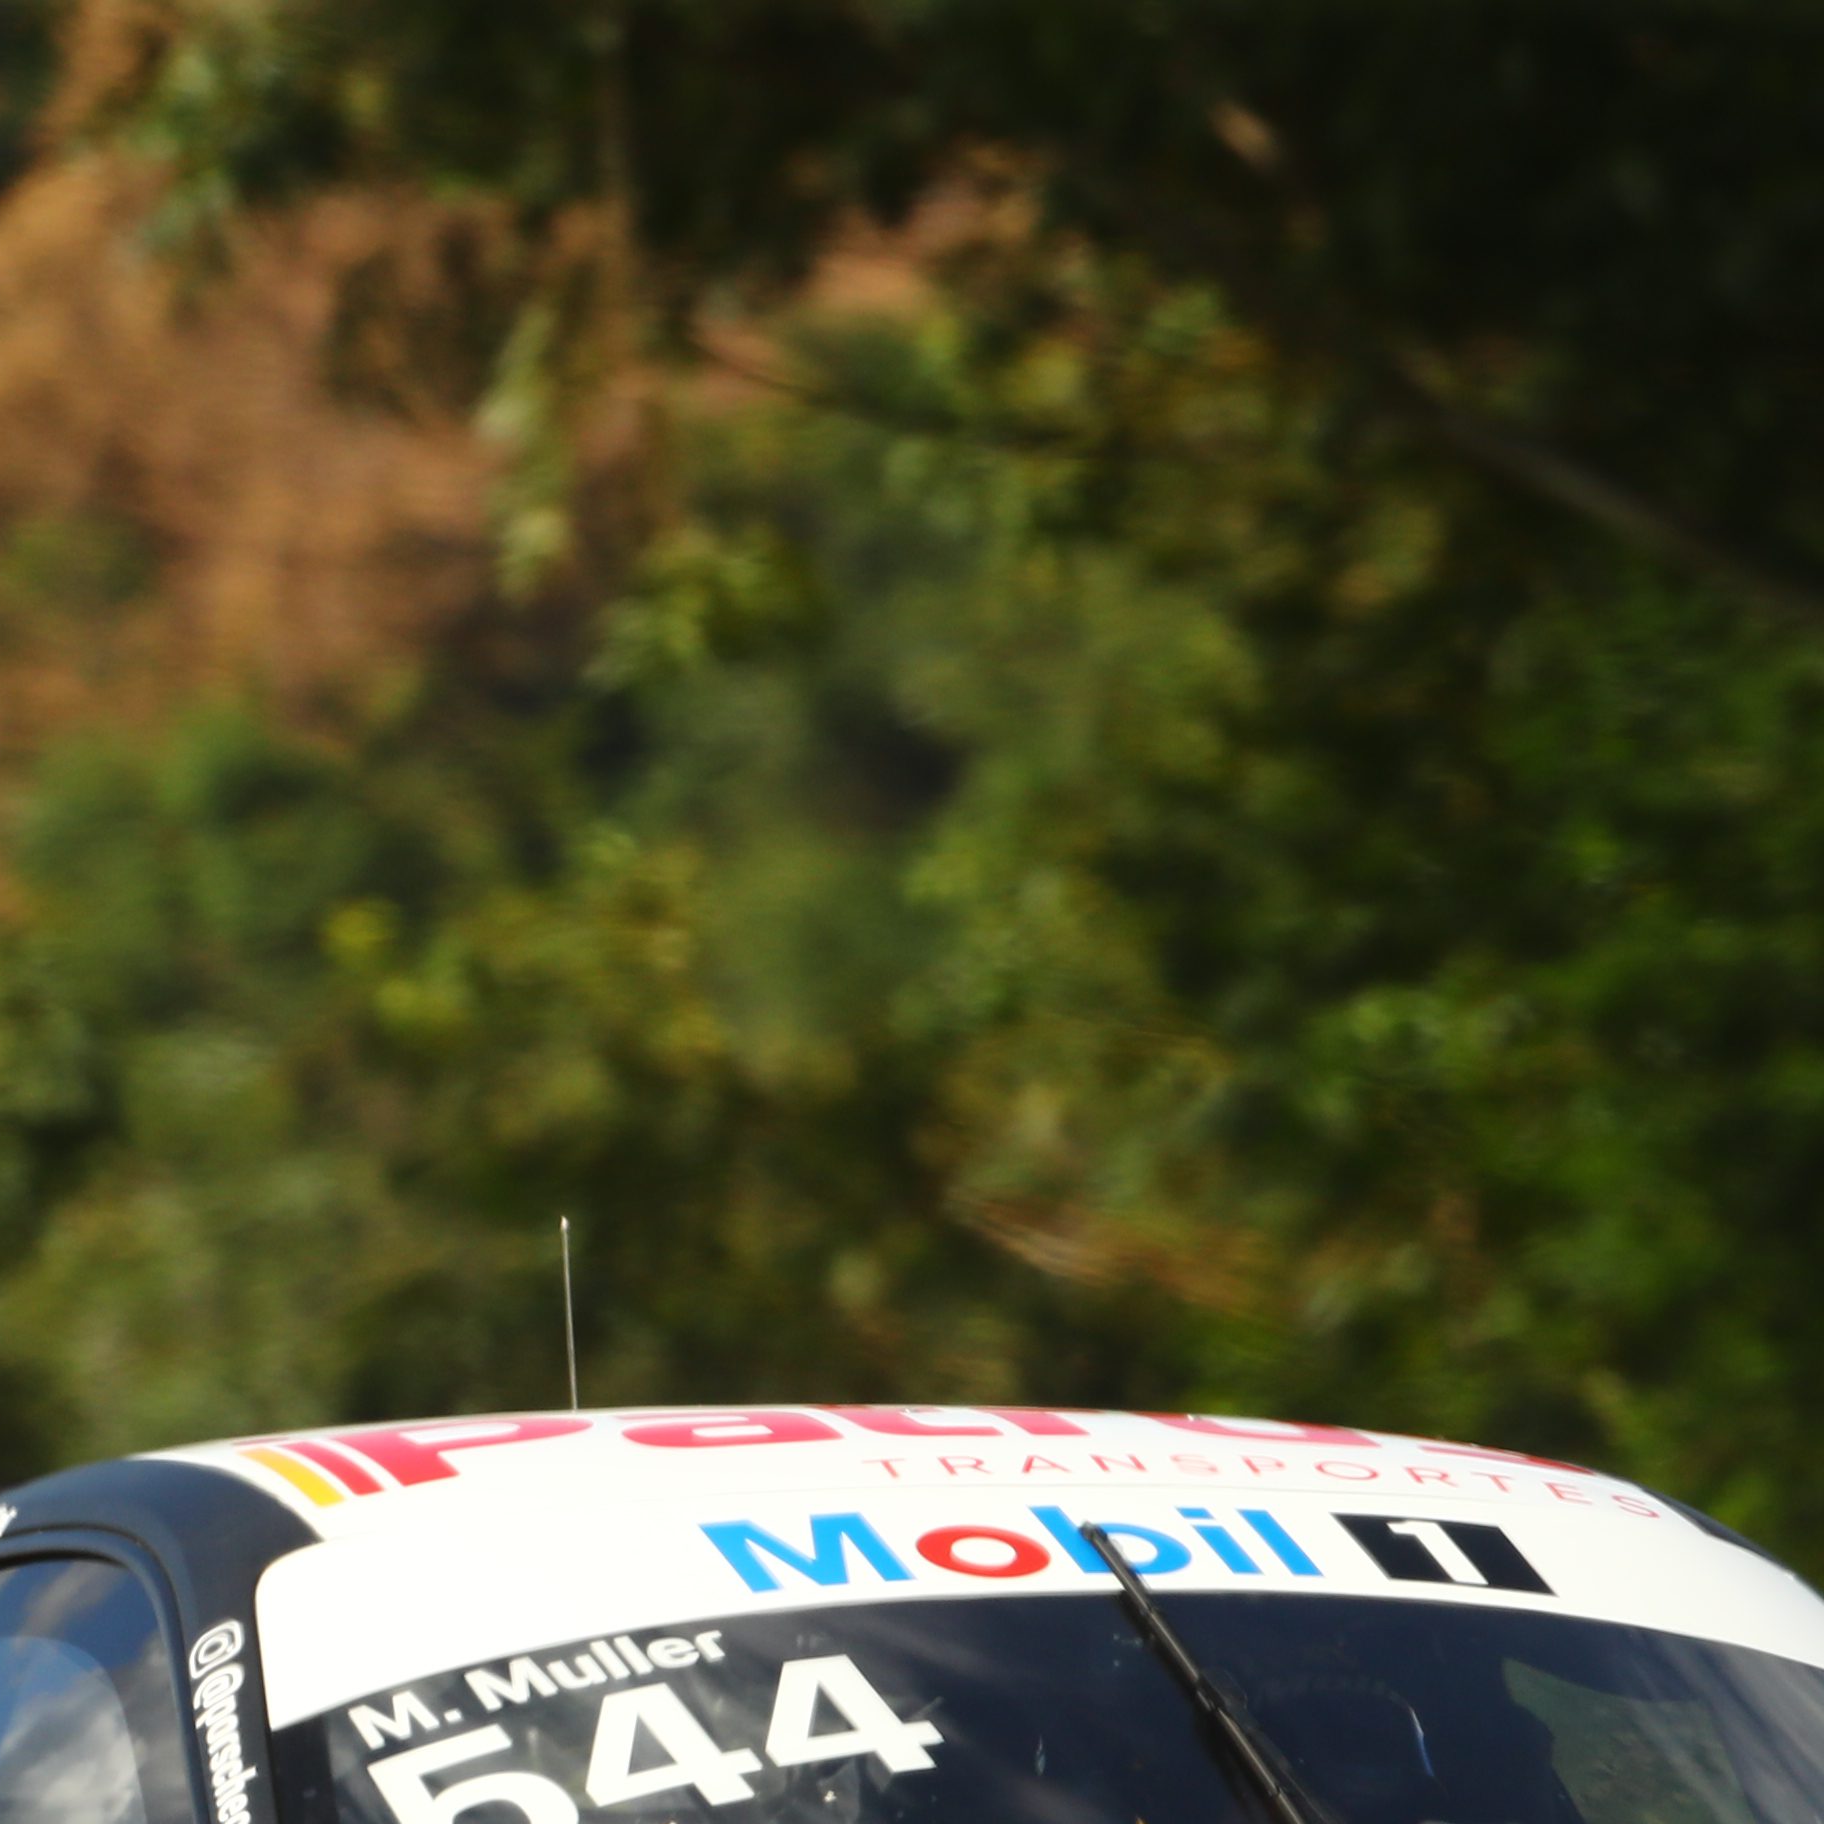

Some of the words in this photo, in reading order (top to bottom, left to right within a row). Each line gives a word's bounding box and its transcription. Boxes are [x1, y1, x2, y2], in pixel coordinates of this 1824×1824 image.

[862, 1453, 1661, 1520] TRANSPORTES
[698, 1504, 1324, 1593] Mobil
[348, 1691, 462, 1750] M.
[464, 1630, 726, 1712] Muller
